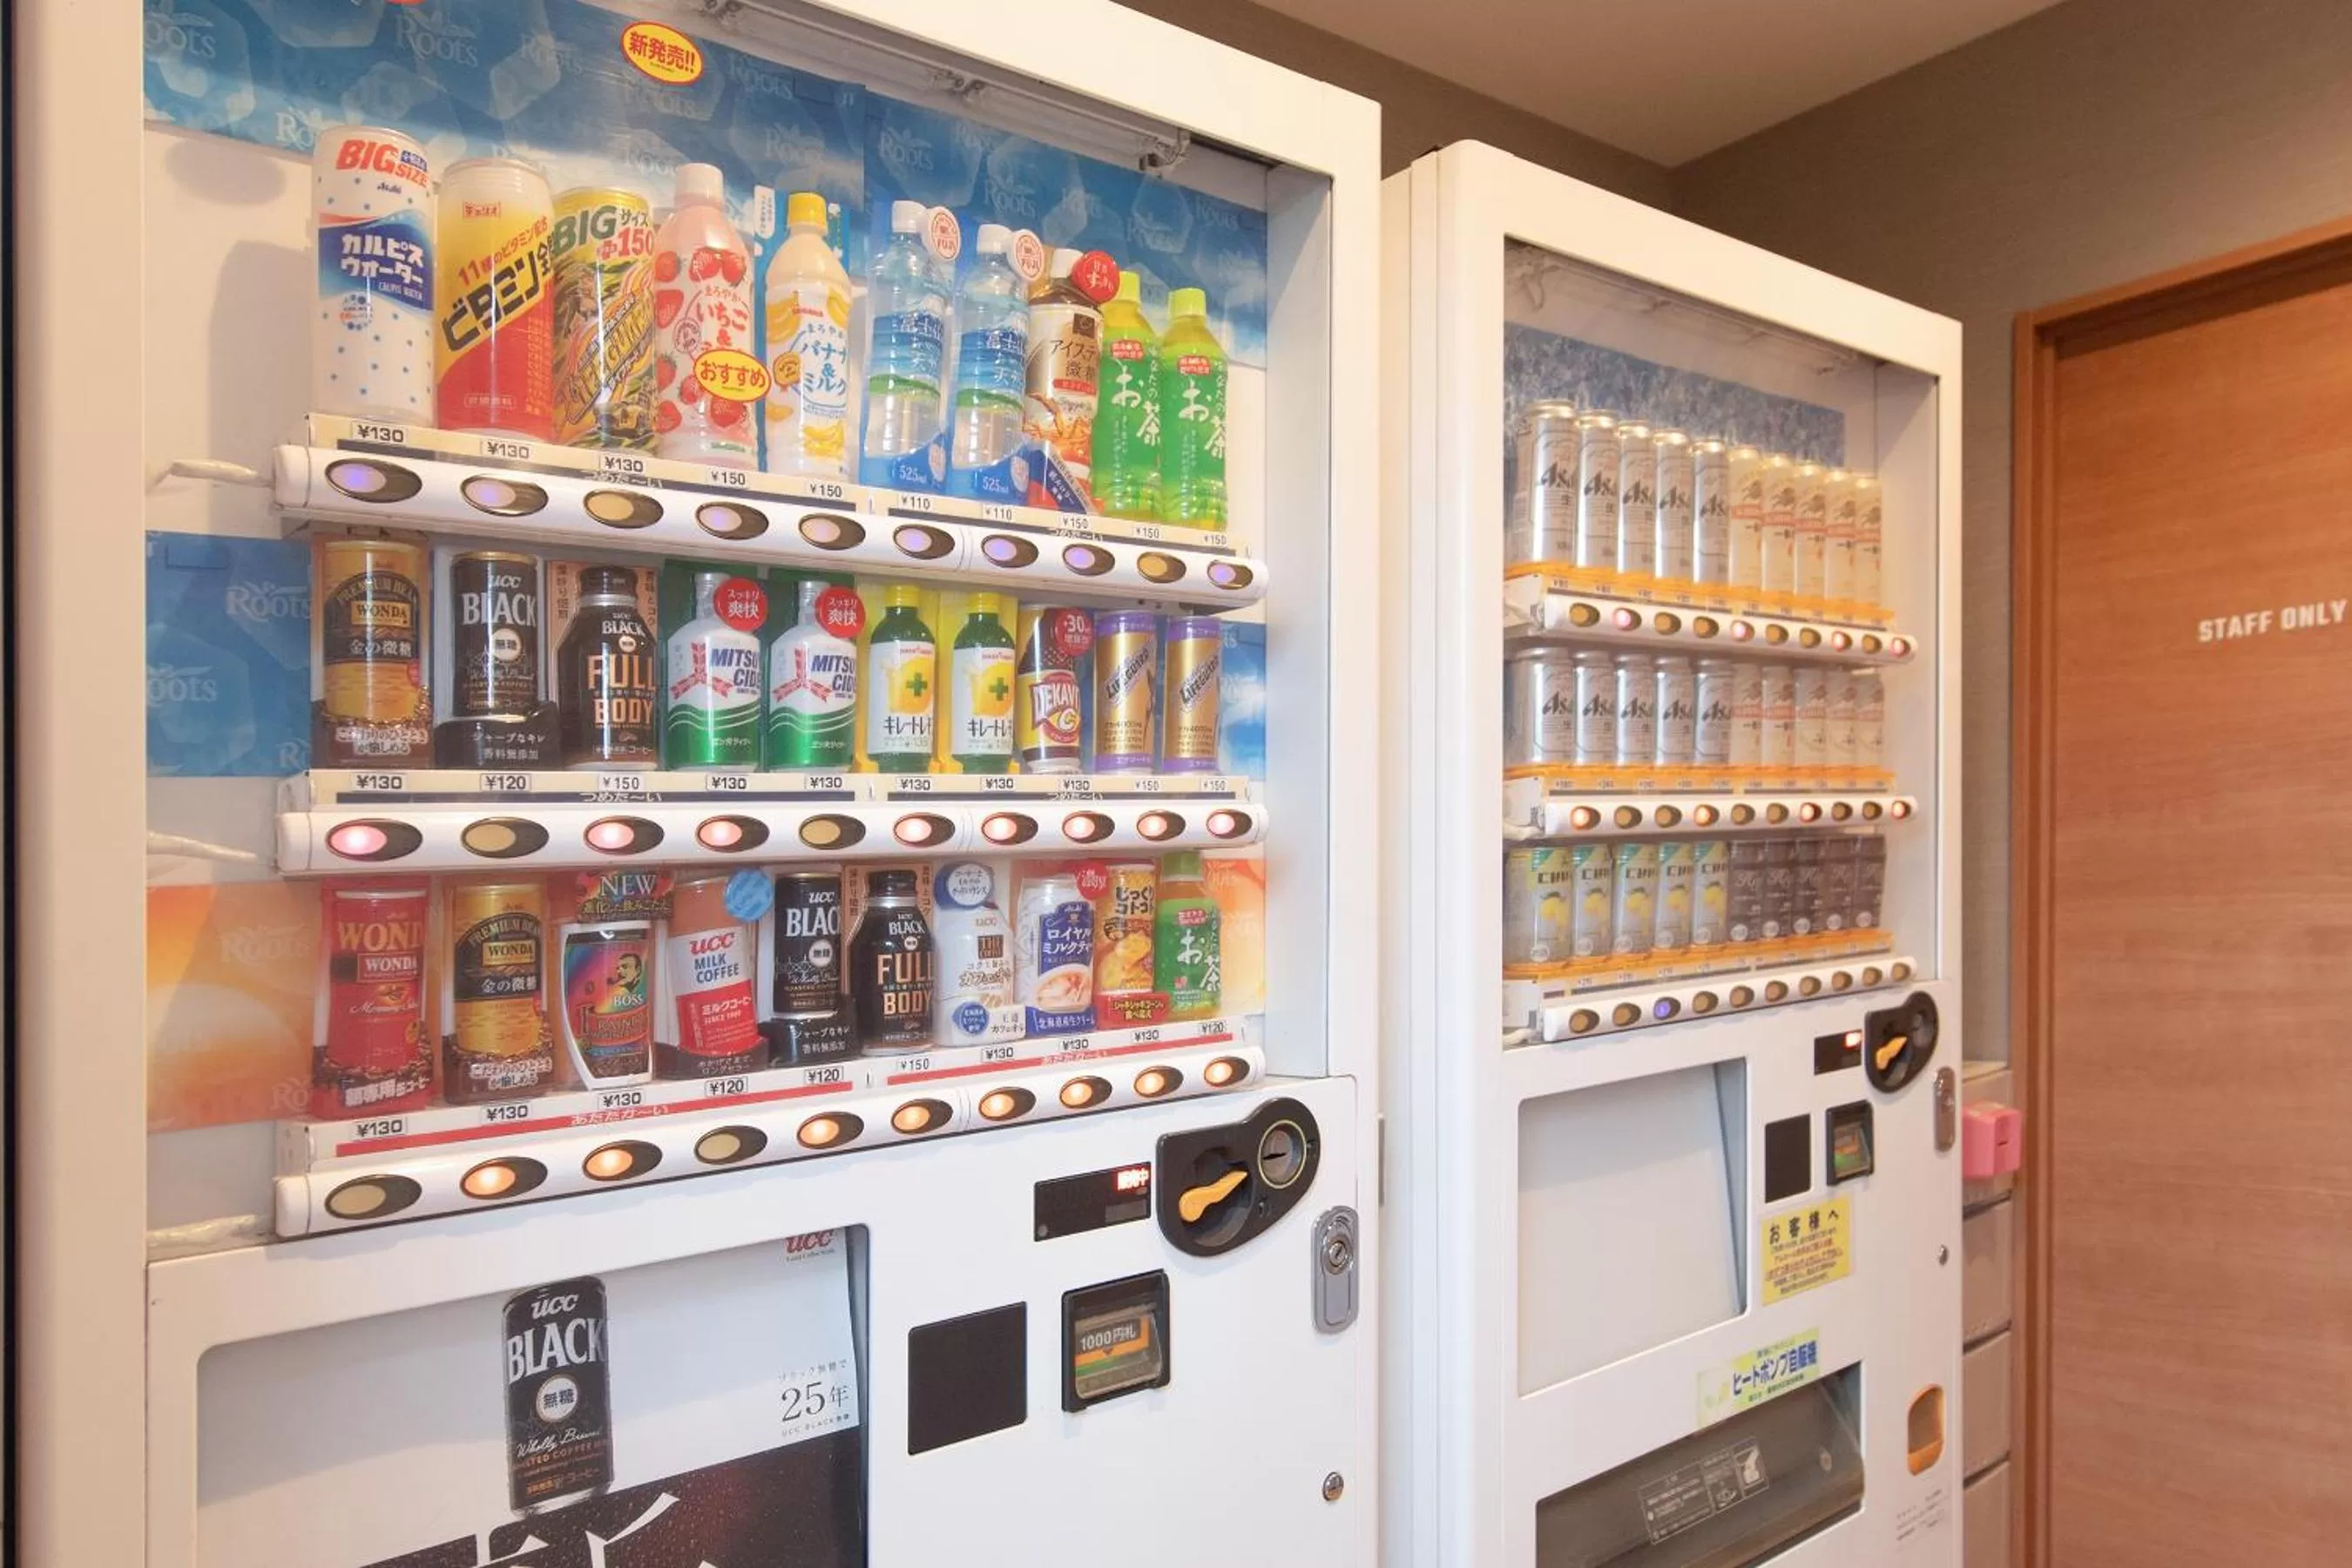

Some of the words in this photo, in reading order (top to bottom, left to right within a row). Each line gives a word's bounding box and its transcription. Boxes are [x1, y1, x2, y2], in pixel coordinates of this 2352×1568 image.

[145, 19, 217, 59] oots
[395, 14, 478, 67] Roots
[629, 31, 696, 73] 新発売!!
[335, 139, 398, 174] BIG
[879, 131, 935, 172] Roots
[395, 162, 428, 189] SIZE
[620, 209, 649, 227] サイズ
[551, 205, 618, 256] BIG
[341, 233, 425, 268] カルピス
[697, 301, 748, 332] いちご
[700, 360, 767, 389] おすすめ
[357, 424, 405, 443] ¥130
[487, 441, 531, 458] ¥130
[605, 456, 644, 472] ¥130
[711, 470, 747, 485] ¥150
[809, 483, 842, 498] ¥150
[902, 496, 930, 510] ¥110
[985, 507, 1012, 521] ¥110
[1063, 516, 1089, 529] ¥150
[1136, 526, 1160, 538] ¥150
[1204, 533, 1227, 545] ¥150
[225, 585, 314, 622] Roots
[355, 602, 409, 619] WONDA
[462, 591, 537, 627] BLACK
[727, 603, 760, 619] 爽快
[828, 610, 858, 626] 爽快
[2198, 610, 2274, 643] STAFF
[2280, 598, 2348, 631] ONLY
[602, 619, 646, 638] BLACK
[587, 654, 656, 692] FULL
[146, 675, 217, 708] oots
[594, 699, 653, 725] BODY
[356, 774, 403, 790] ¥130
[484, 775, 527, 790] ¥120
[603, 777, 639, 790] ¥150
[712, 776, 747, 789] ¥130
[810, 776, 843, 788] ¥130
[901, 779, 930, 791] ¥130
[985, 777, 1014, 789] ¥130
[1064, 780, 1091, 791] ¥130
[1135, 780, 1159, 791] ¥150
[1203, 780, 1226, 791] ¥150
[599, 873, 658, 897] NEW
[786, 906, 840, 937] BLAC
[889, 921, 925, 936] BLACK
[488, 943, 533, 958] WONDA
[693, 953, 727, 970] MILK
[696, 963, 740, 983] COFFEE
[883, 990, 932, 1016] BODY
[1201, 1021, 1225, 1033] ¥120
[1063, 1038, 1089, 1051] ¥130
[1134, 1030, 1160, 1042] ¥130
[985, 1046, 1014, 1060] ¥130
[900, 1058, 930, 1071] ¥150
[808, 1069, 840, 1083] ¥120
[709, 1079, 745, 1095] ¥120
[603, 1092, 641, 1107] ¥130
[486, 1105, 529, 1120] ¥130
[357, 1119, 402, 1137] ¥130
[1769, 1209, 1840, 1245] お客様へ
[1079, 1322, 1137, 1351] 1000円札
[507, 1316, 609, 1385] BLACK
[1732, 1339, 1818, 1397] ヒートポンプ自販機
[543, 1388, 574, 1410] 無糖
